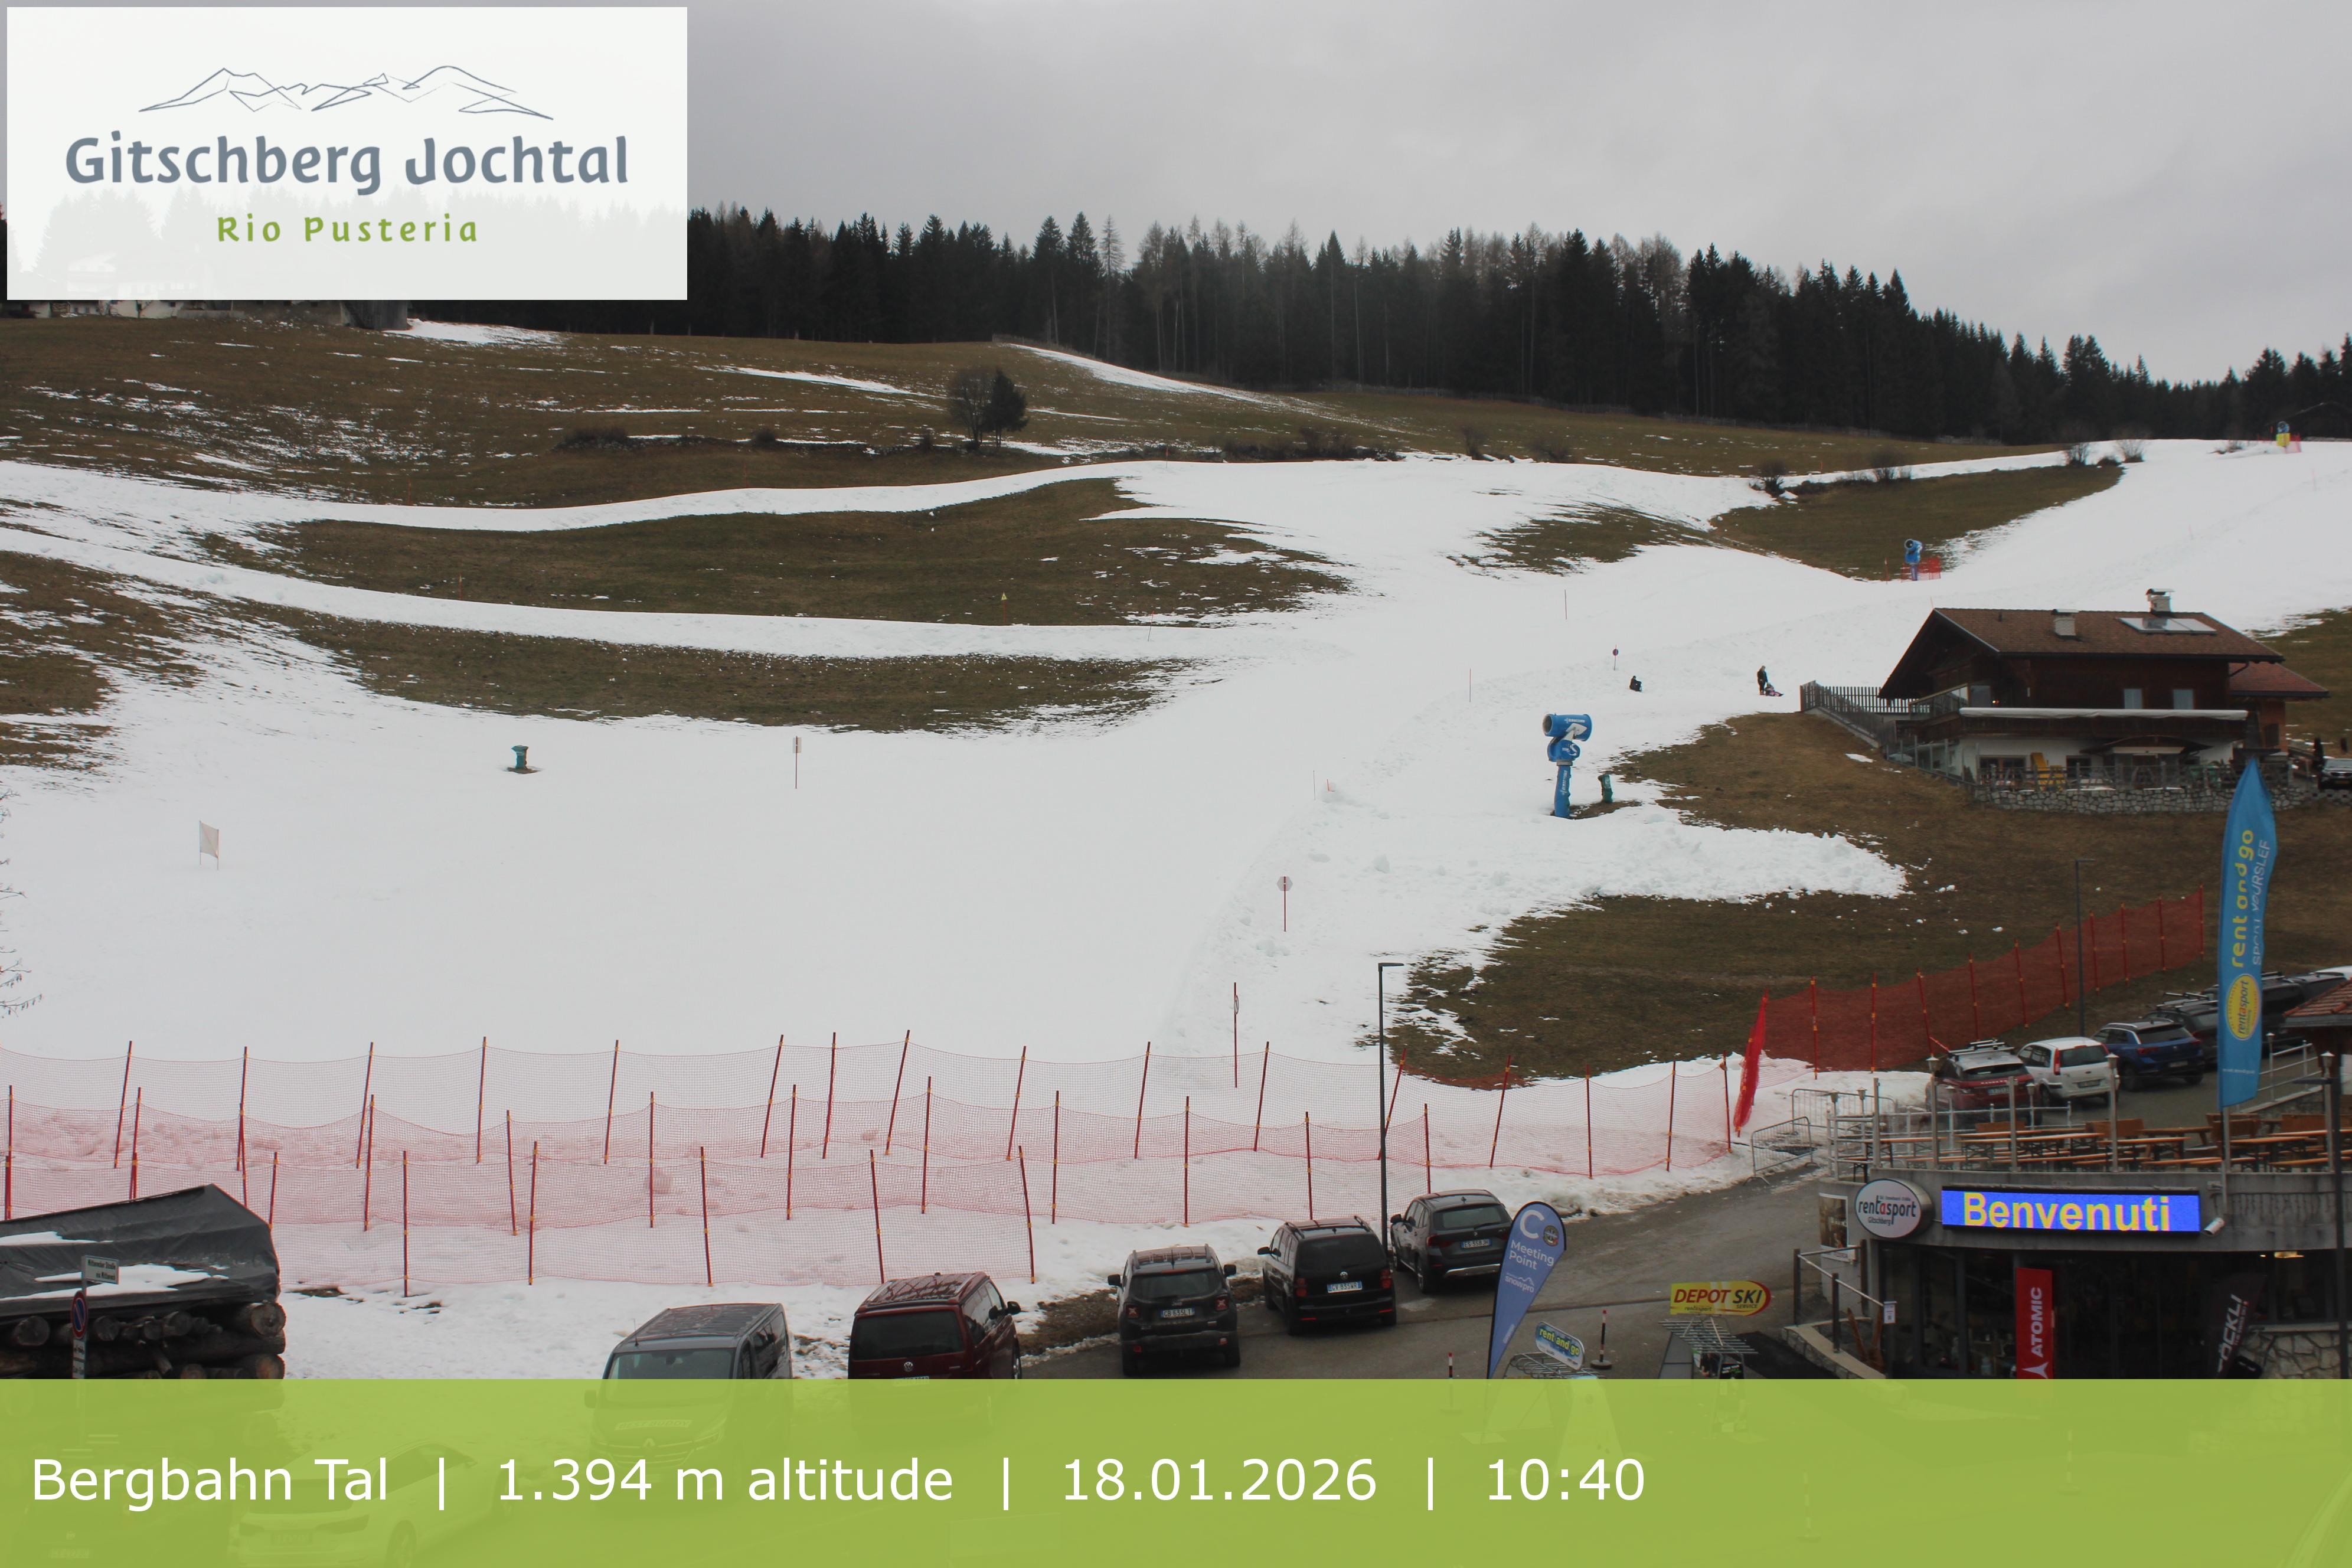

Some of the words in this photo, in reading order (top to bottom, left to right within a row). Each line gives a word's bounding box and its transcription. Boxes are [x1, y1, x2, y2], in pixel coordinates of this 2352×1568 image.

[2238, 829, 2255, 861] go
[2232, 916, 2248, 968] rent
[1520, 1209, 1545, 1239] C
[1858, 1195, 1917, 1225] rentasport
[1868, 1216, 1892, 1226] Gitschberg
[1964, 1191, 2170, 1231] Benvenuti
[1509, 1250, 1537, 1270] Point
[1511, 1240, 1554, 1266] Meeting
[1505, 1275, 1534, 1293] snowpro
[1674, 1289, 1732, 1304] DEPOT
[1732, 1289, 1763, 1304] SKI
[2030, 1287, 2043, 1358] ATOMIC
[1539, 1328, 1555, 1342] rent
[1556, 1337, 1570, 1350] and
[1570, 1345, 1580, 1355] go
